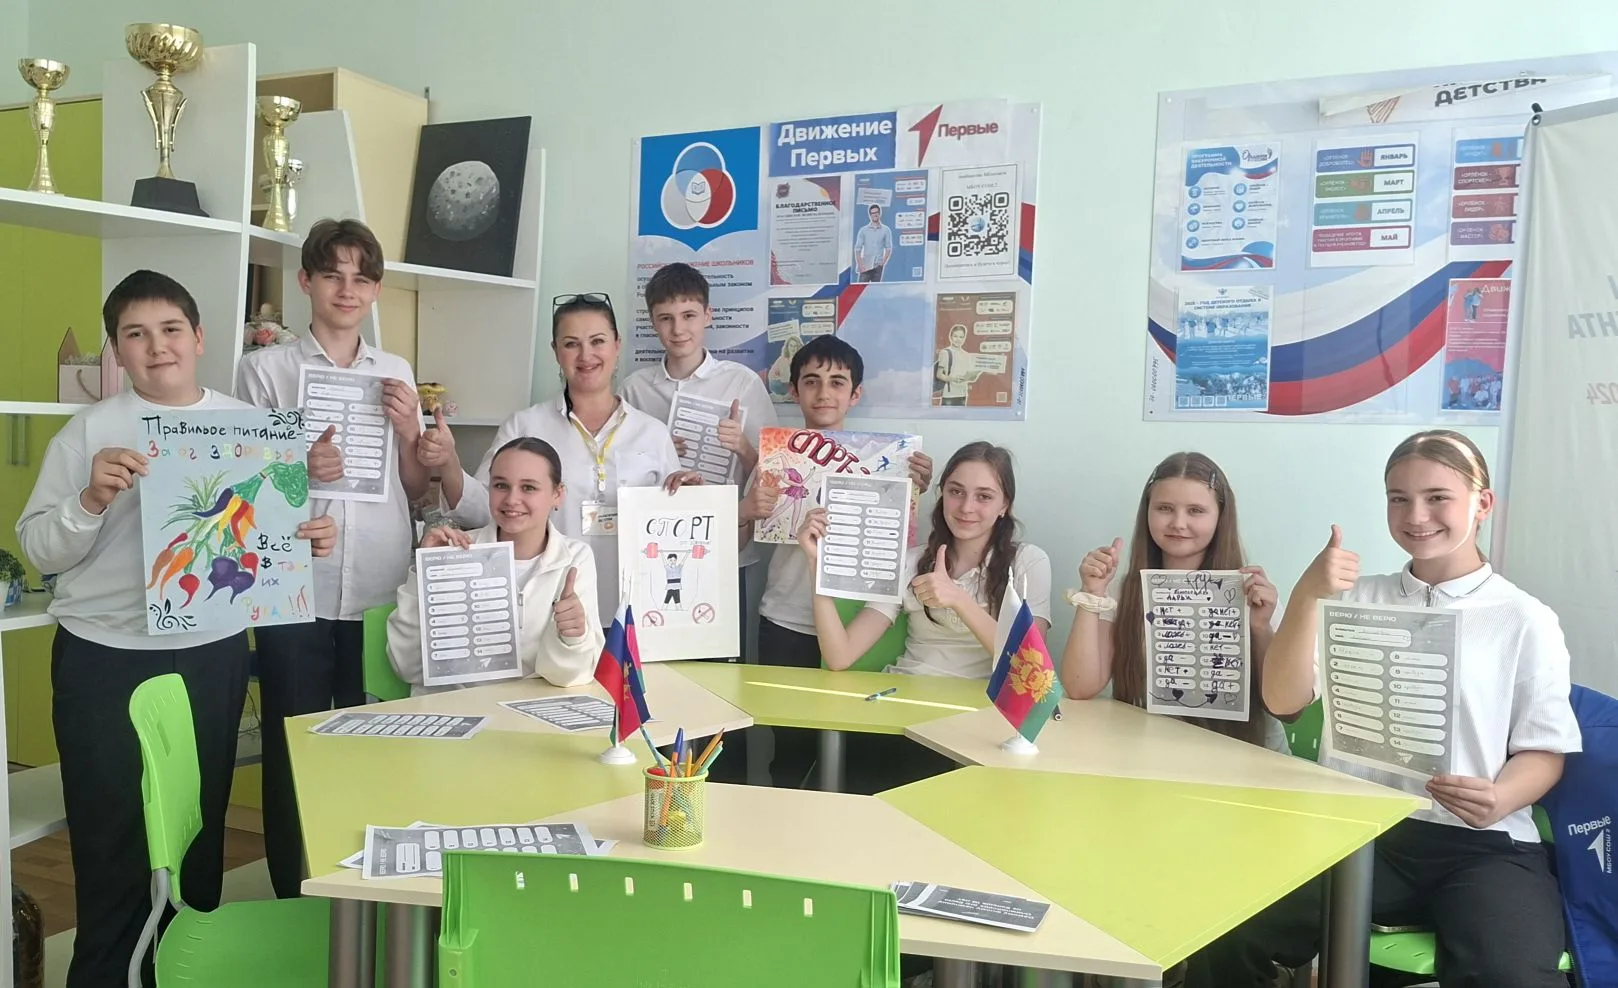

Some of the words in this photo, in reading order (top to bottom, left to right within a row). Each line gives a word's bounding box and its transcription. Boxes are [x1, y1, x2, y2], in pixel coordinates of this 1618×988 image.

[1434, 78, 1546, 107] ДЕТСТВА
[778, 119, 892, 146] Движение
[938, 121, 998, 140] Первые
[791, 147, 878, 168] Первых
[1380, 152, 1408, 160] ЯНВАРЬ
[776, 200, 836, 208] БЛАГОДАРСТВЕННОЕ
[1481, 284, 1511, 293] Движ
[147, 440, 197, 460] Заог
[787, 428, 859, 474] СПОРТ
[646, 515, 714, 540] СПОРТ
[257, 532, 292, 552] Всё
[1568, 815, 1612, 836] Первые
